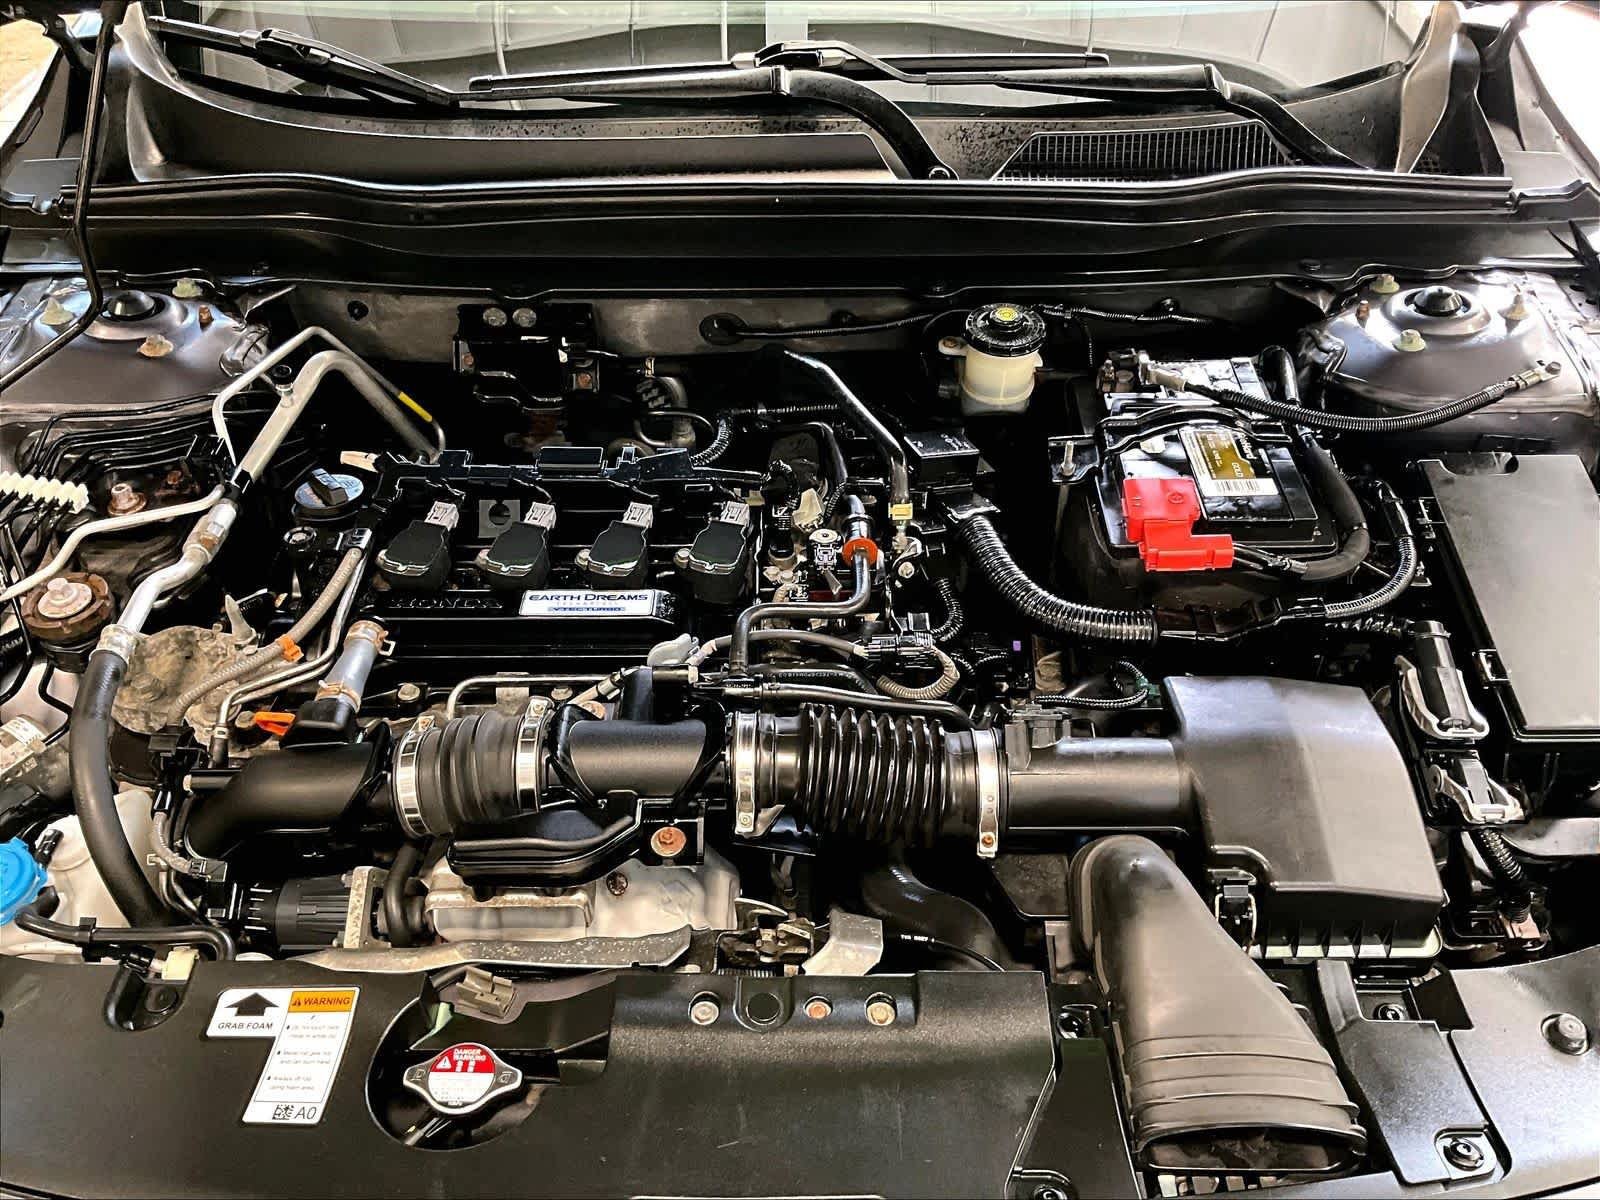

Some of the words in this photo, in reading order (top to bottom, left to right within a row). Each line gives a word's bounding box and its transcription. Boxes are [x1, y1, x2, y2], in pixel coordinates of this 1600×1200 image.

[1232, 462, 1243, 477] GOLD
[584, 593, 648, 601] DREAMS
[304, 997, 351, 1005] WARNING
[217, 1022, 245, 1030] GRAB
[246, 1022, 273, 1030] FOAM
